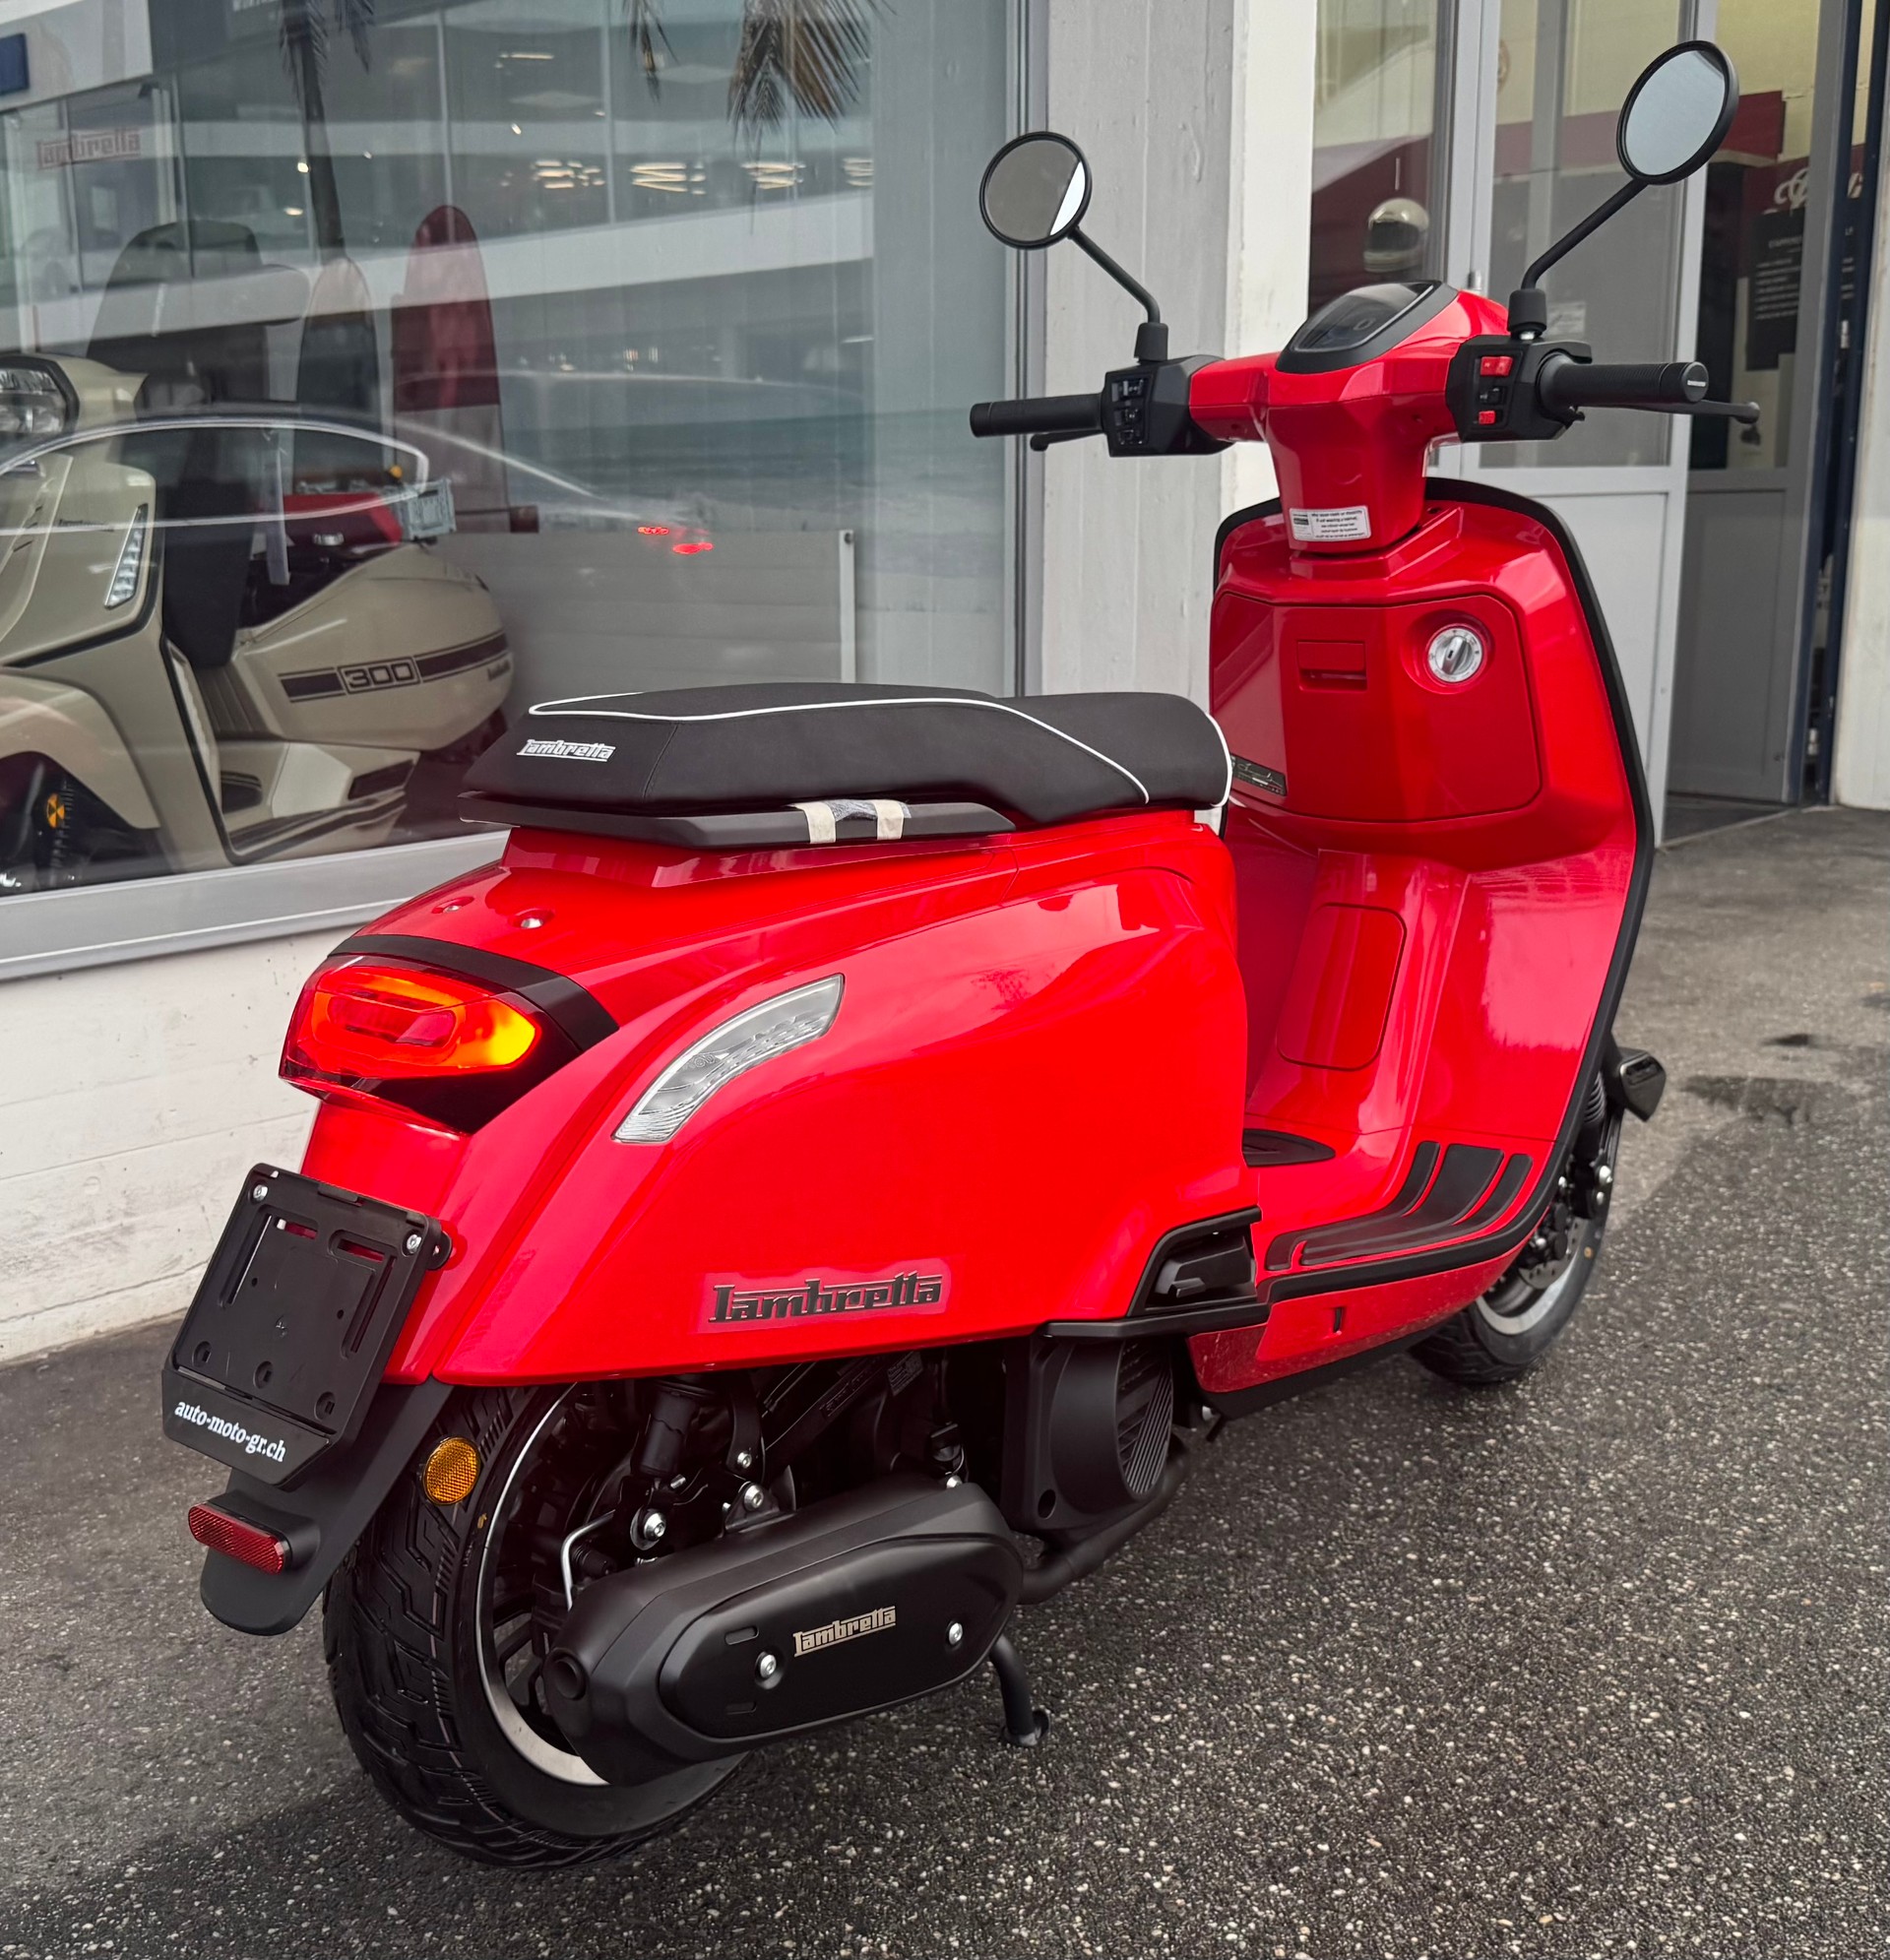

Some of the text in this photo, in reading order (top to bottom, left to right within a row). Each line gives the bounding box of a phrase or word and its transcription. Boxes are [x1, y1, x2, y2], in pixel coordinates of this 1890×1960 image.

[345, 662, 414, 689] 300
[708, 1270, 942, 1323] Lambretta
[174, 1400, 287, 1462] auto-moto-gr.ch
[792, 1606, 897, 1658] Lambretta
